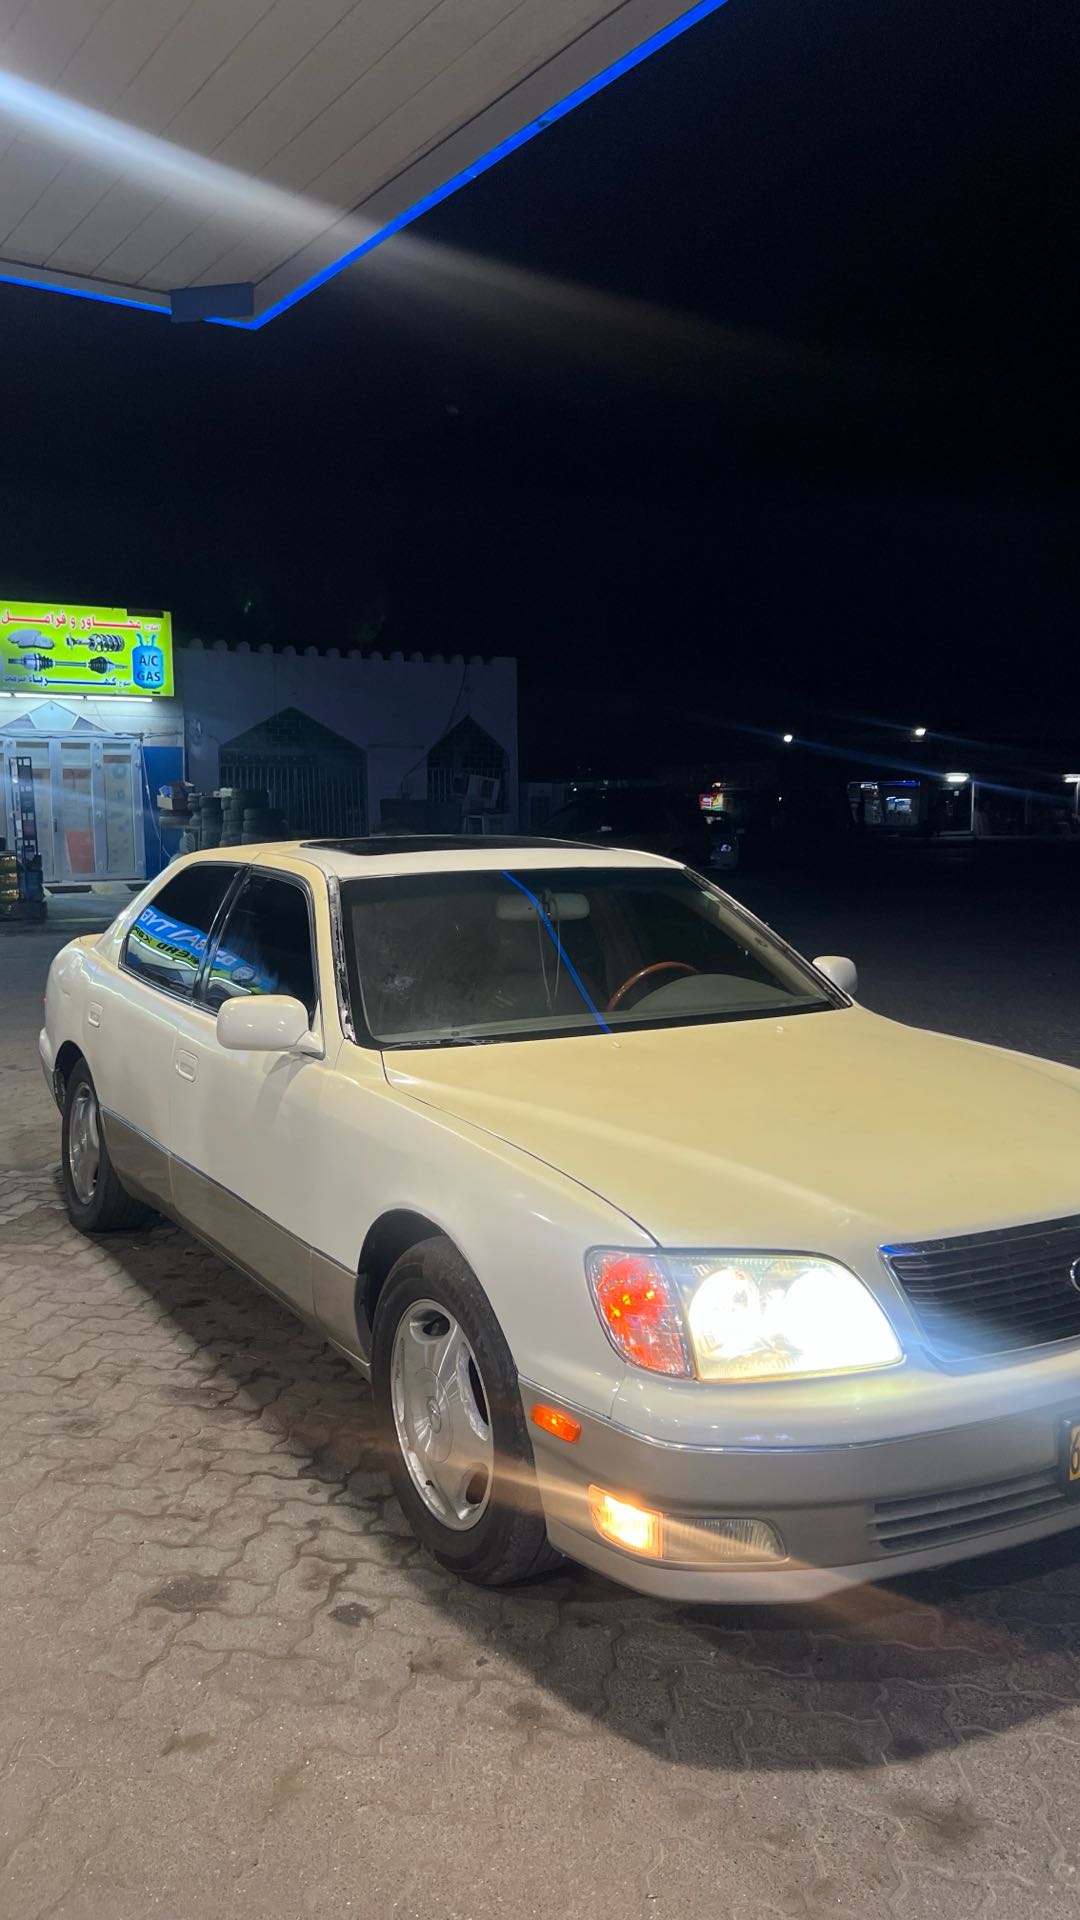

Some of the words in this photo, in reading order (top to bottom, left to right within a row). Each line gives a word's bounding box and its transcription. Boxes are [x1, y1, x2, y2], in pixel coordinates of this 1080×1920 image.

[70, 617, 76, 629] و
[139, 655, 158, 667] A/C
[136, 671, 161, 682] GAS
